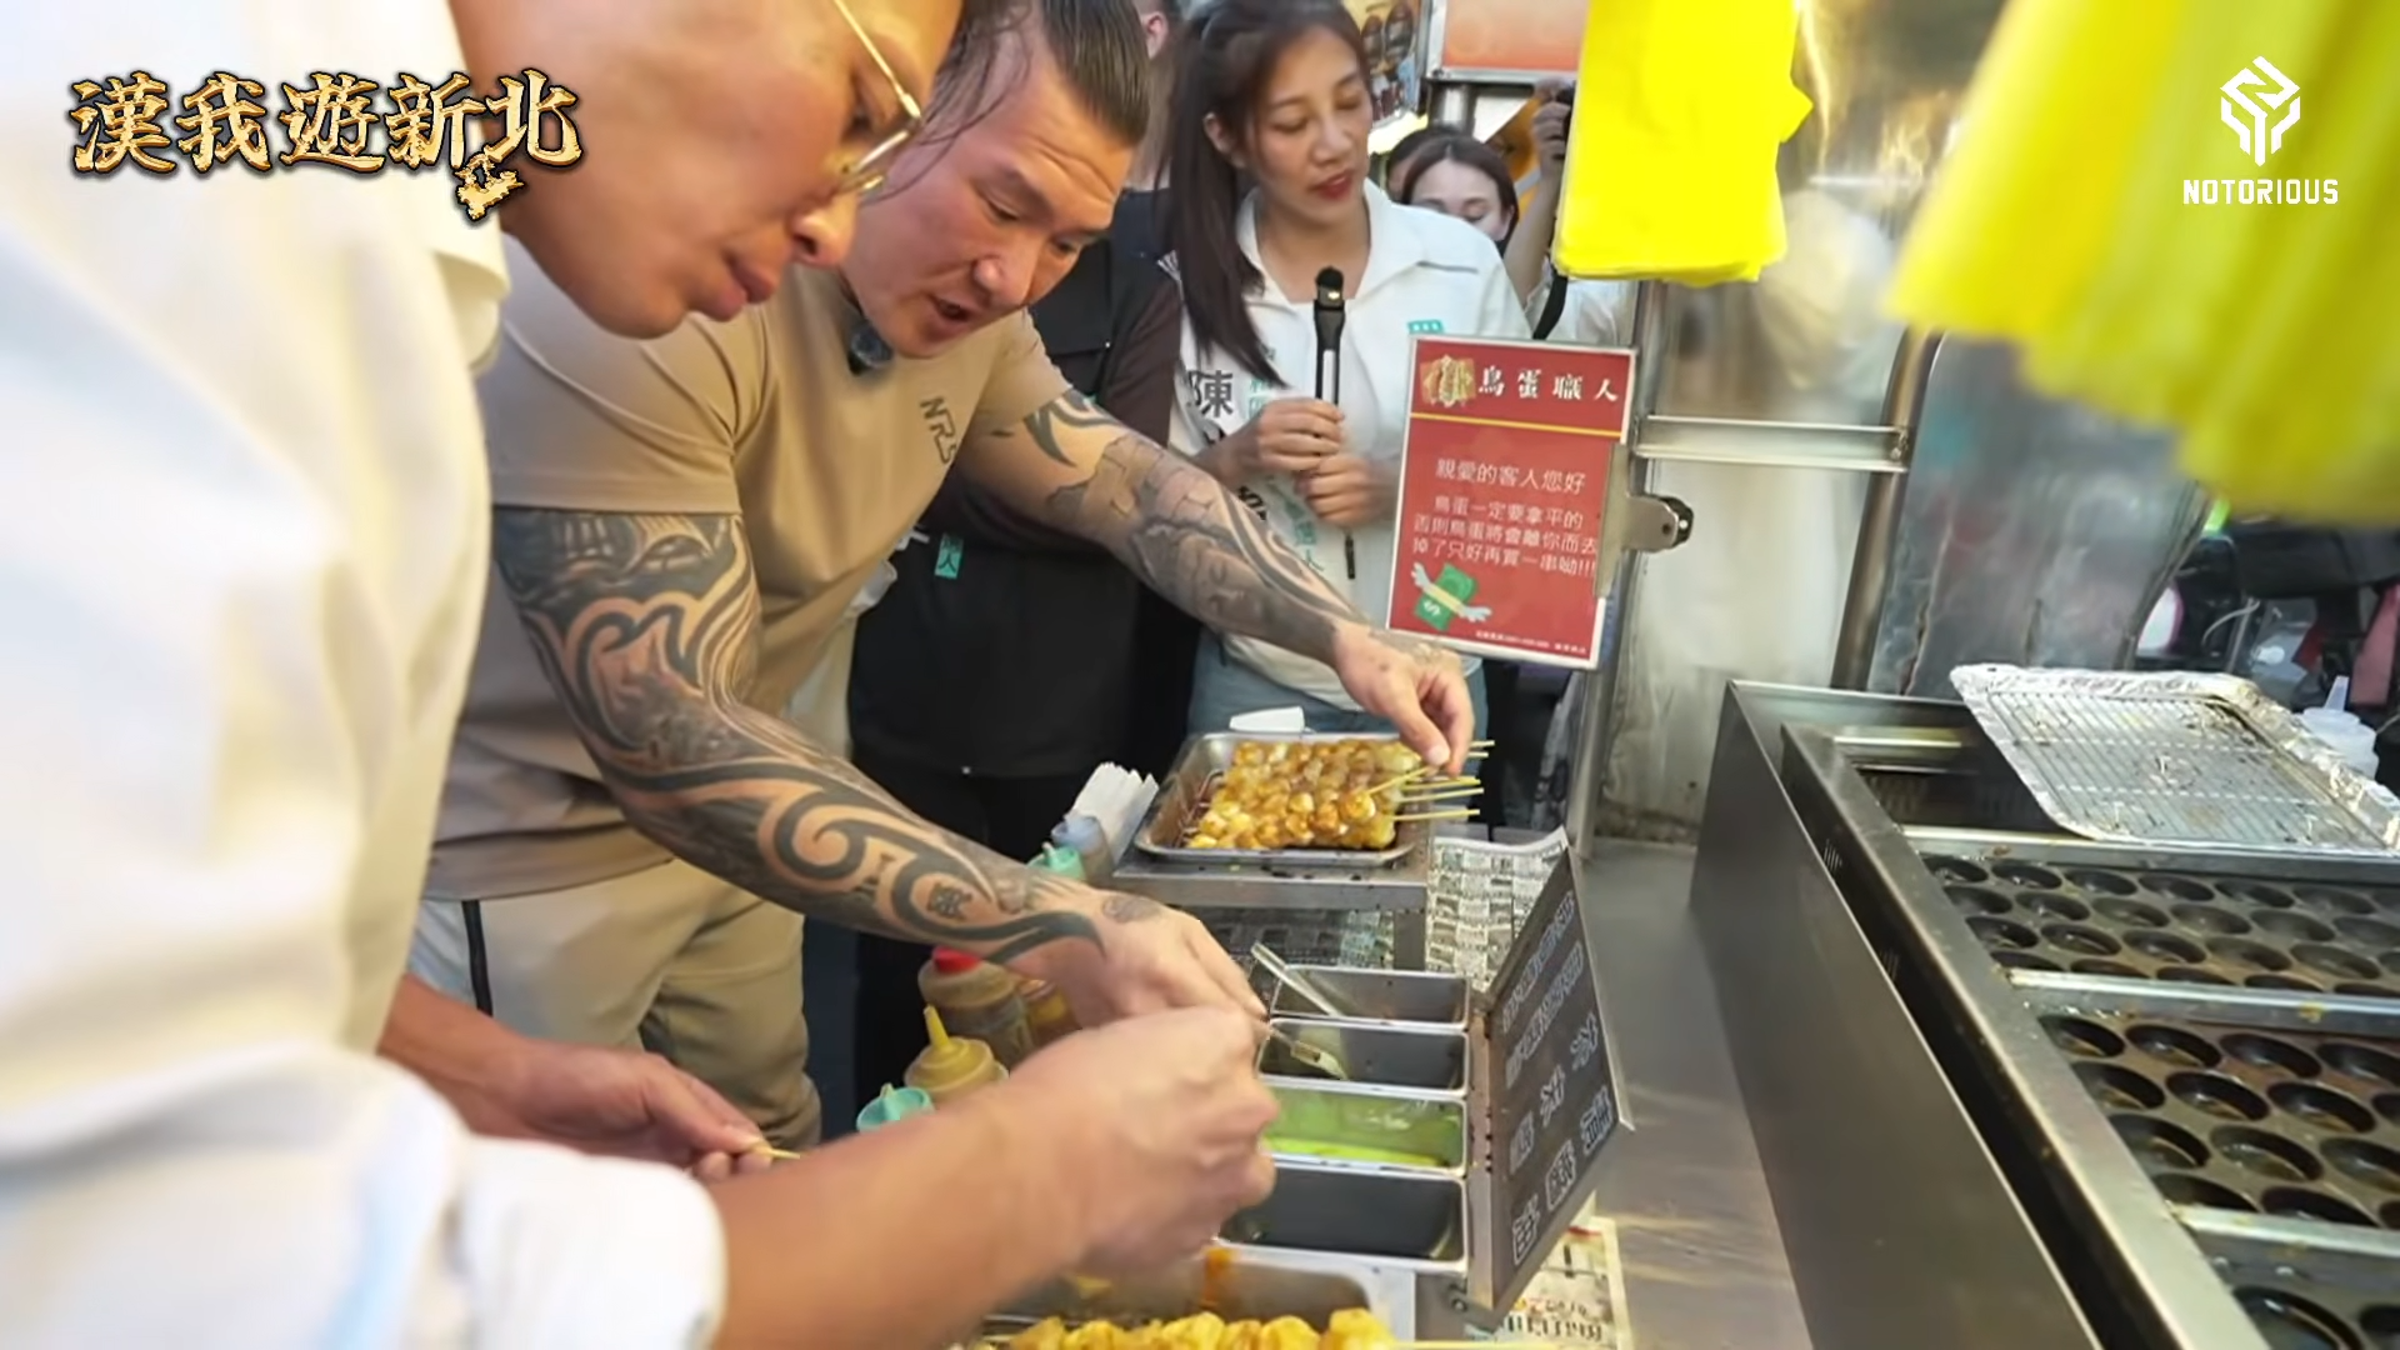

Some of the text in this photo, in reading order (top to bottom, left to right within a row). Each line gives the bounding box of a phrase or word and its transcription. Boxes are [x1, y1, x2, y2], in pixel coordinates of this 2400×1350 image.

[1435, 457, 1586, 495] 親愛的客人您好
